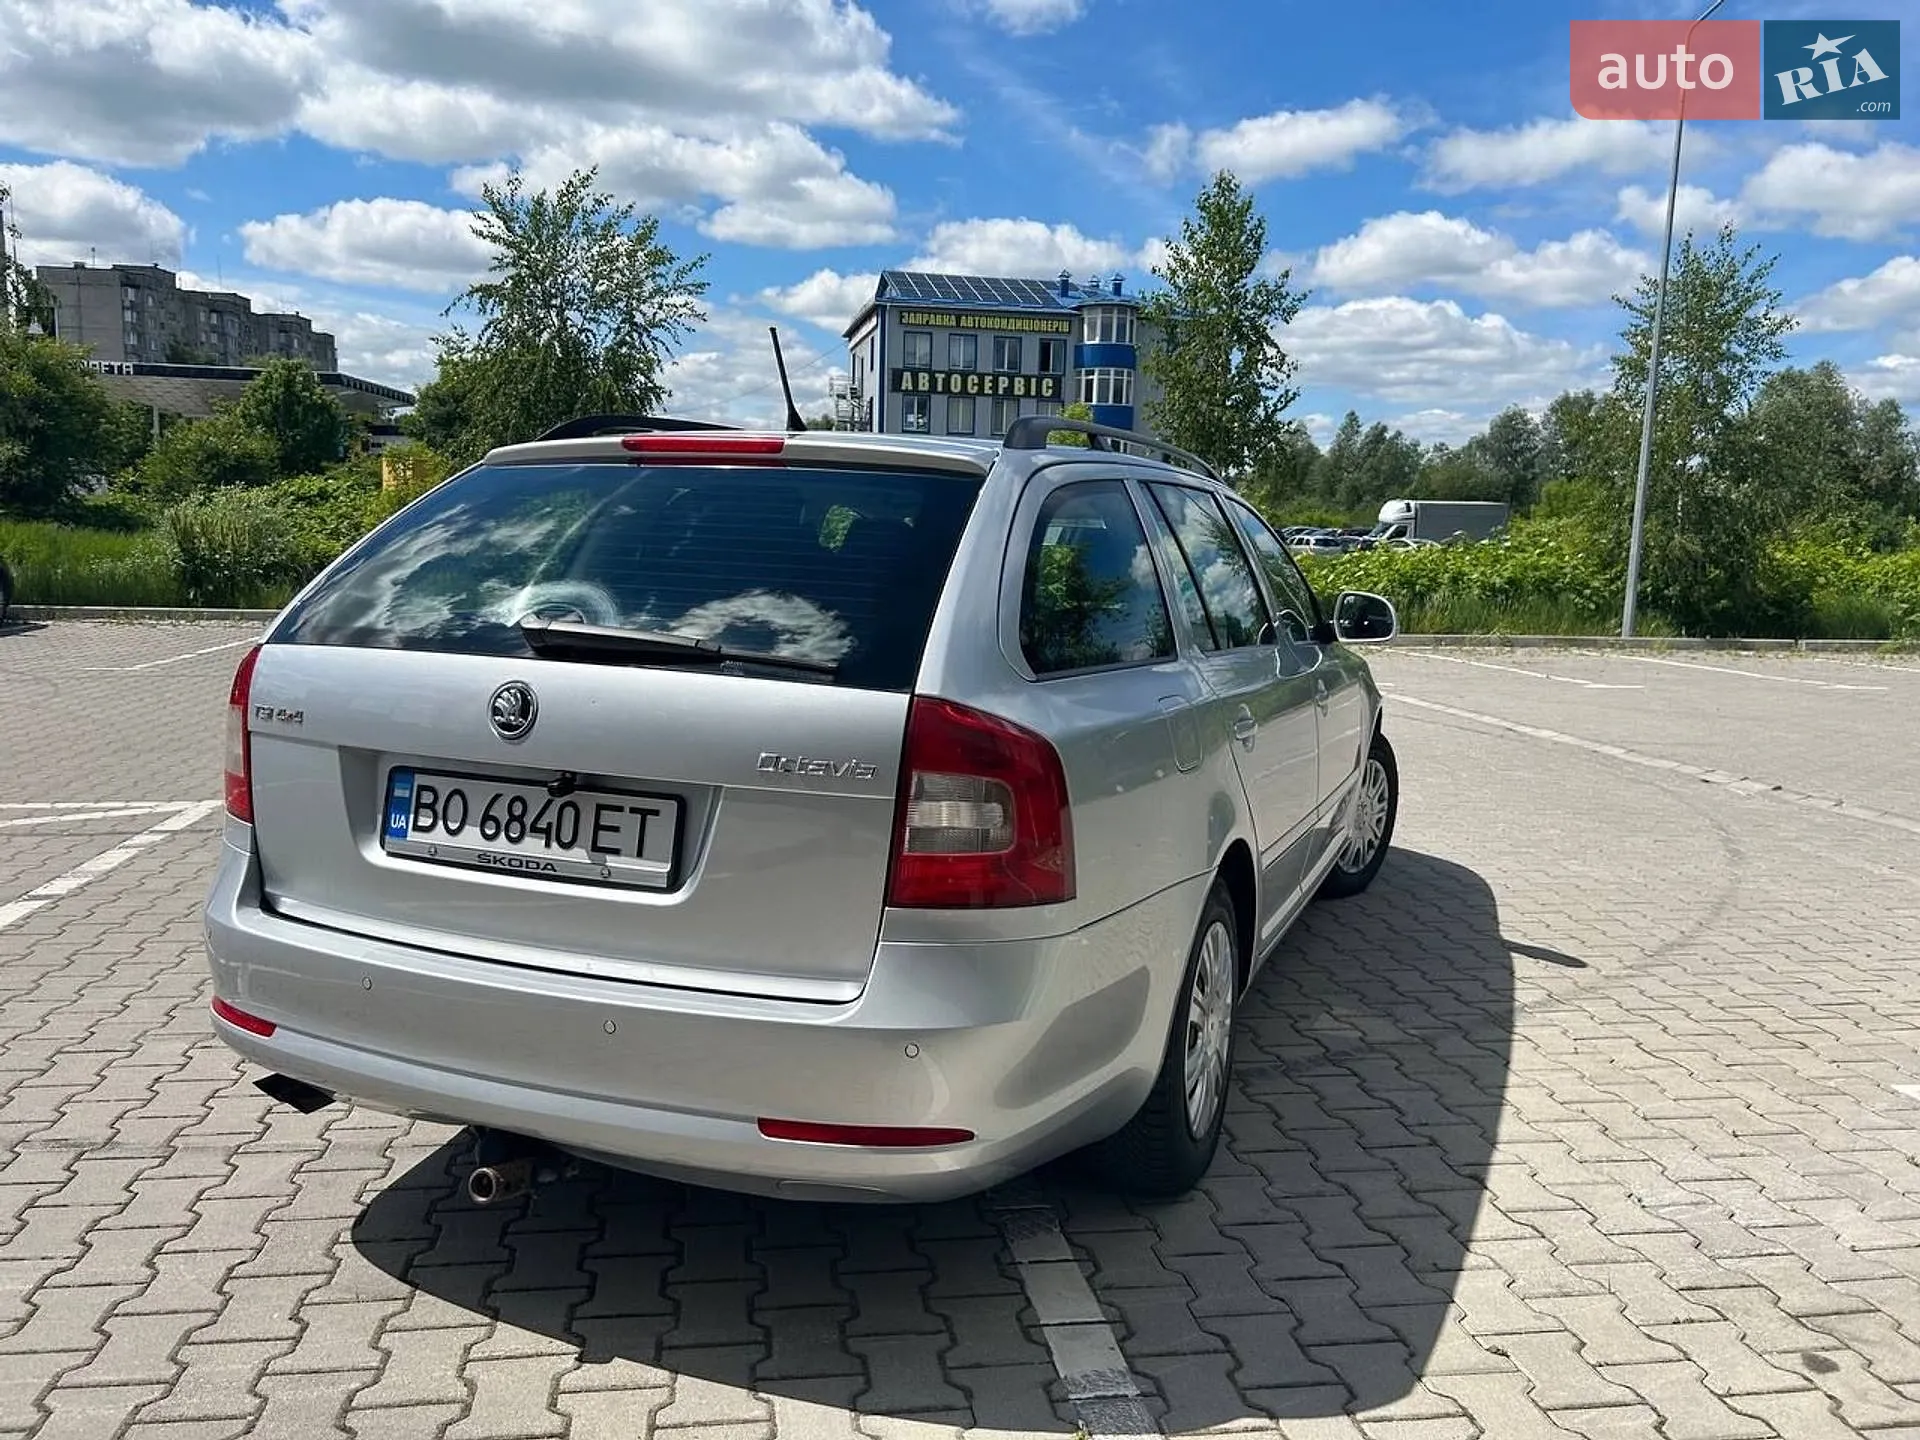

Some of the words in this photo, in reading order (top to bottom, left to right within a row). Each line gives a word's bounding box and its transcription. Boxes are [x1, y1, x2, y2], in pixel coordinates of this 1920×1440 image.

[901, 311, 957, 327] ЗАПРАВКА
[901, 371, 1054, 397] АВТОСЕРВІС
[757, 752, 878, 780] Octavia
[391, 812, 407, 829] UA
[412, 784, 469, 836] BO
[479, 792, 580, 850] 6840
[591, 803, 660, 858] ET
[477, 852, 558, 873] ŠKODA
